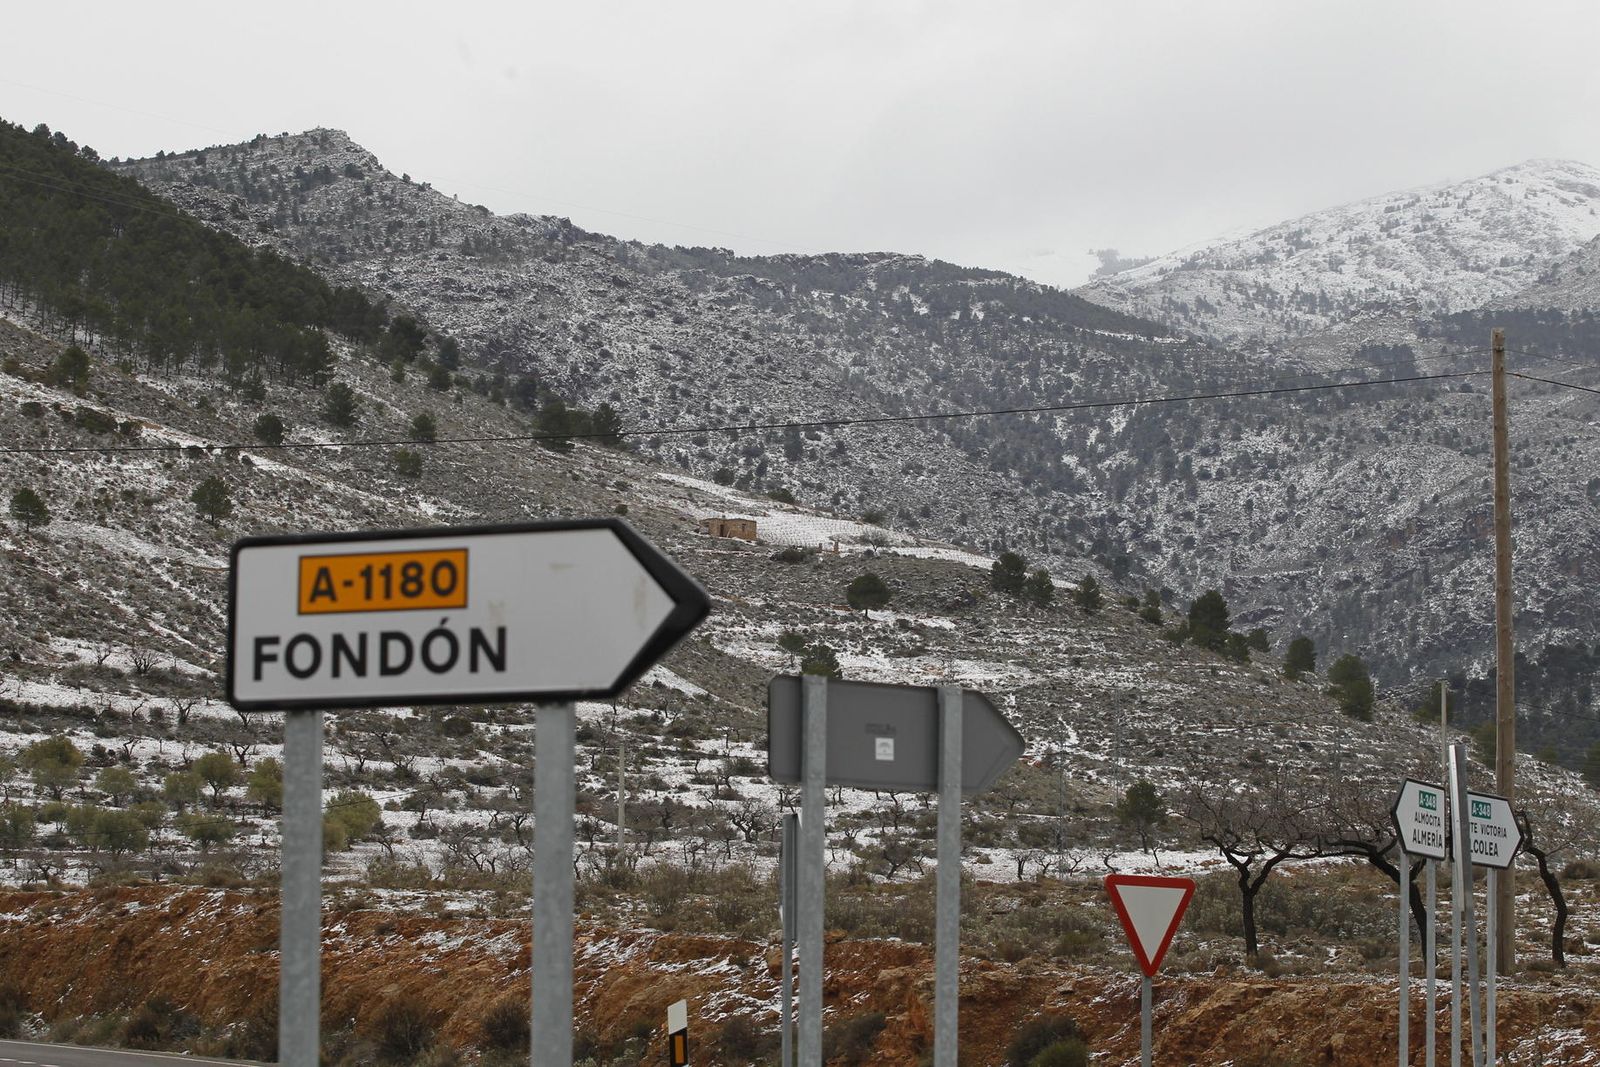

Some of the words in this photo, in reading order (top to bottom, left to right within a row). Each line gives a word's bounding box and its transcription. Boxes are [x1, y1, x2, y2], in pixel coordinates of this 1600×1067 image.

[309, 559, 458, 604] A-1180
[252, 618, 507, 681] FONDÓN
[1472, 803, 1490, 817] A-348
[1412, 828, 1443, 849] ALMERÍA
[1480, 824, 1507, 838] VICTORIA
